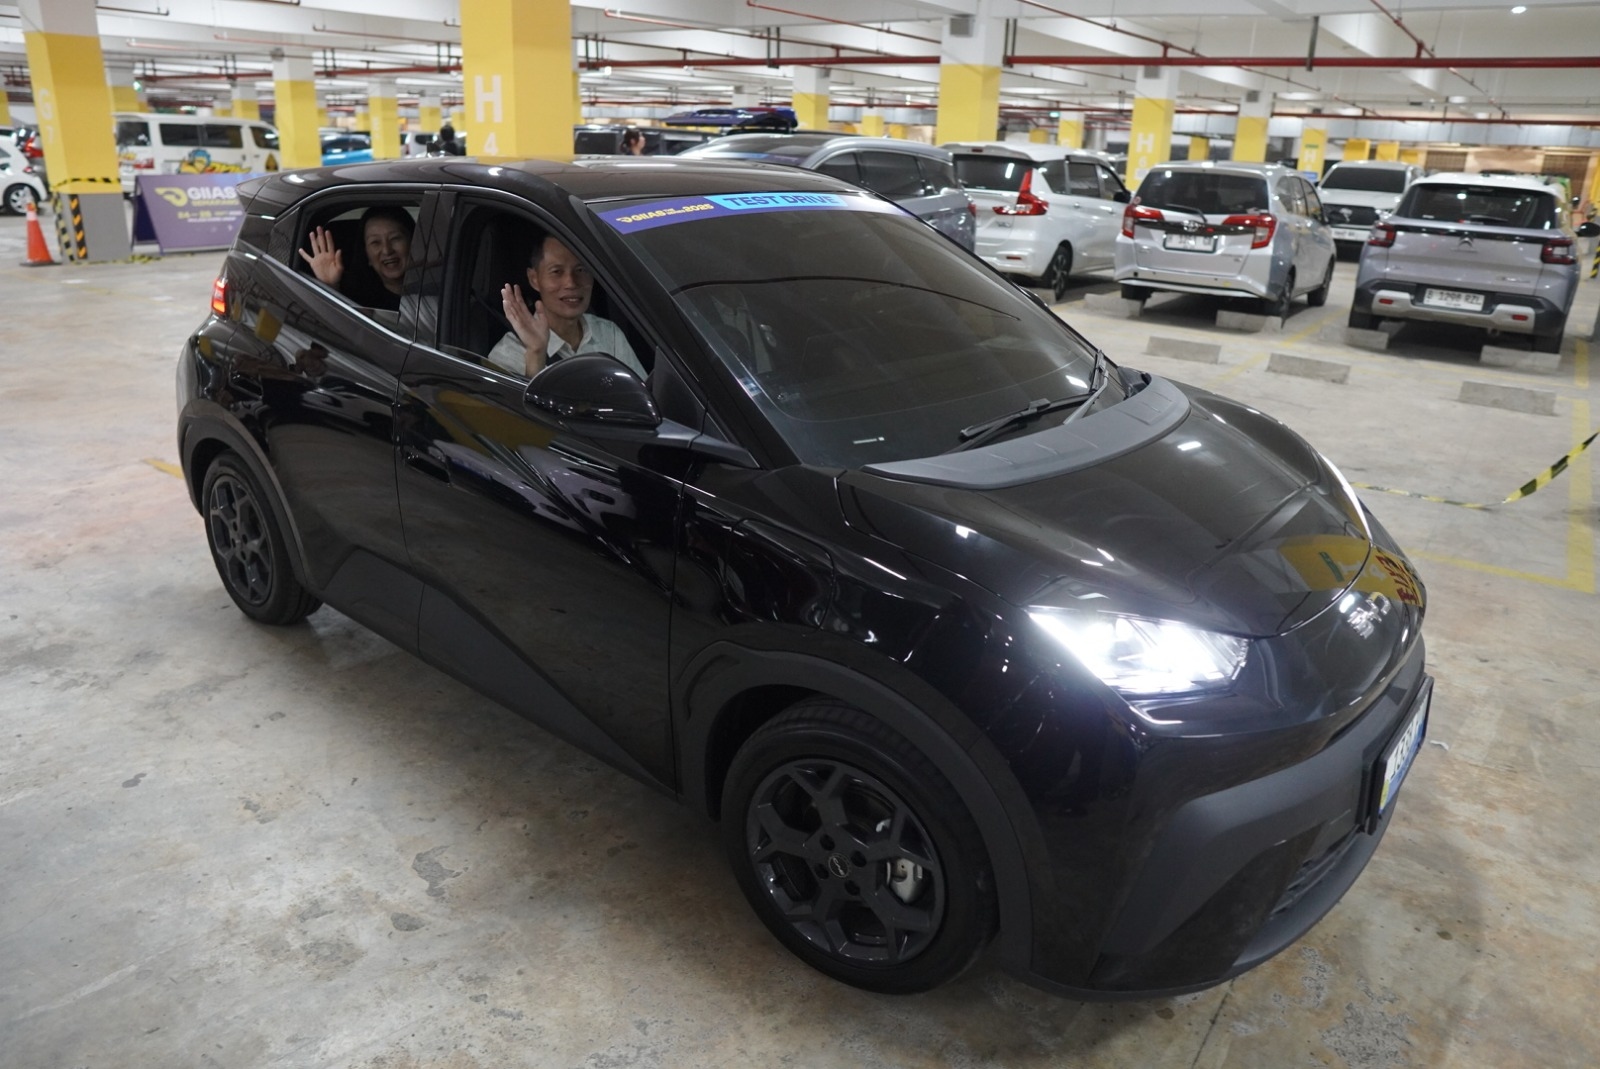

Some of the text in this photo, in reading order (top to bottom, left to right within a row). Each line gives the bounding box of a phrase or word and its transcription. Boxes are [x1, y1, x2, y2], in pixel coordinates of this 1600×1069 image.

[474, 74, 503, 123] H
[484, 132, 499, 156] 4
[1136, 132, 1155, 153] H
[187, 186, 237, 200] GIIAS
[723, 195, 841, 207] TEST DRIVE
[631, 209, 666, 221] GIIAS
[682, 203, 714, 212] 2025
